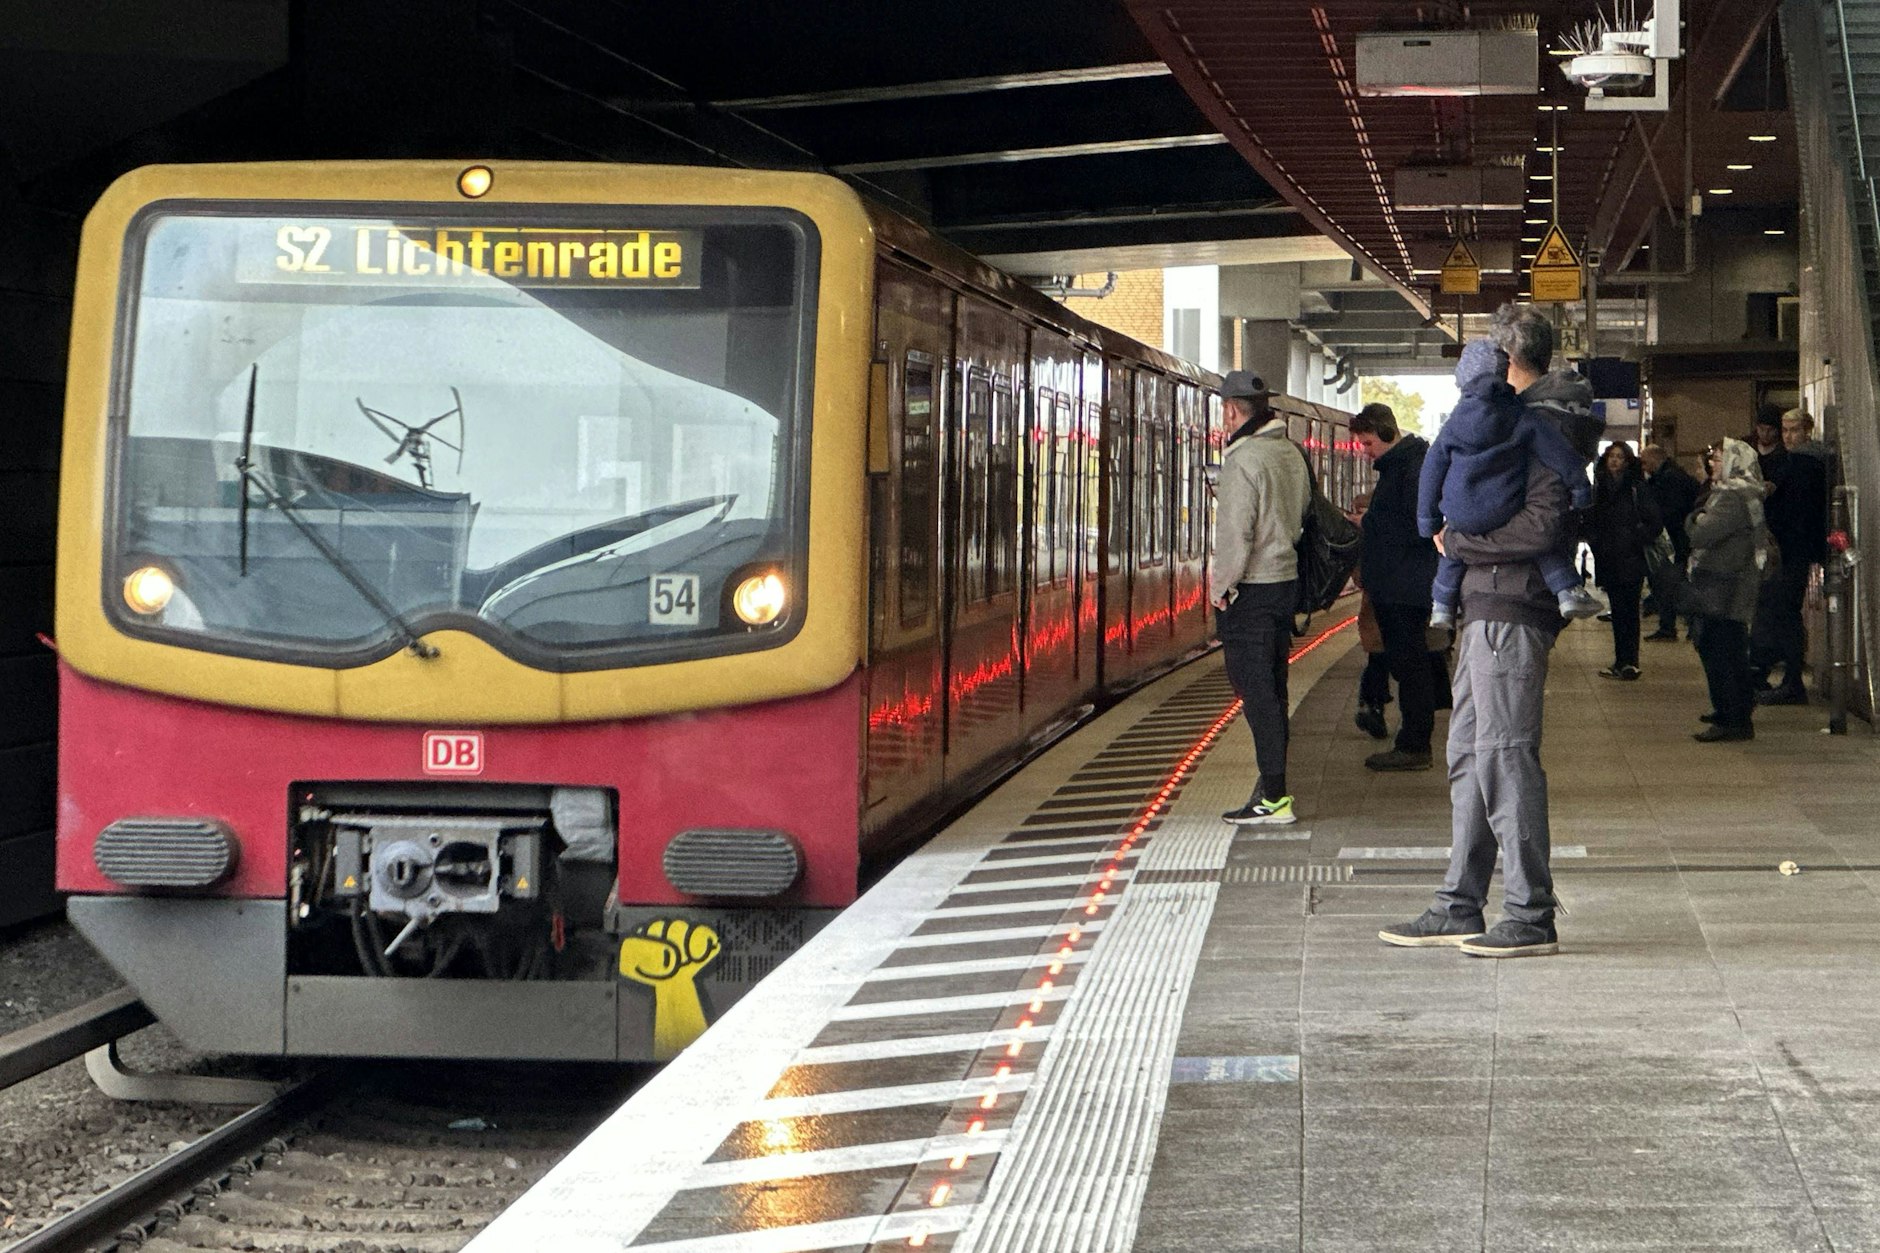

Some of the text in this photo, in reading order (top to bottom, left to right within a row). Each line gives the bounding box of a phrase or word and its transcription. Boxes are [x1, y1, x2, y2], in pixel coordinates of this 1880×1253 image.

[276, 224, 683, 279] S2 Lichtenrade
[653, 578, 696, 615] 54
[432, 739, 476, 766] DB
